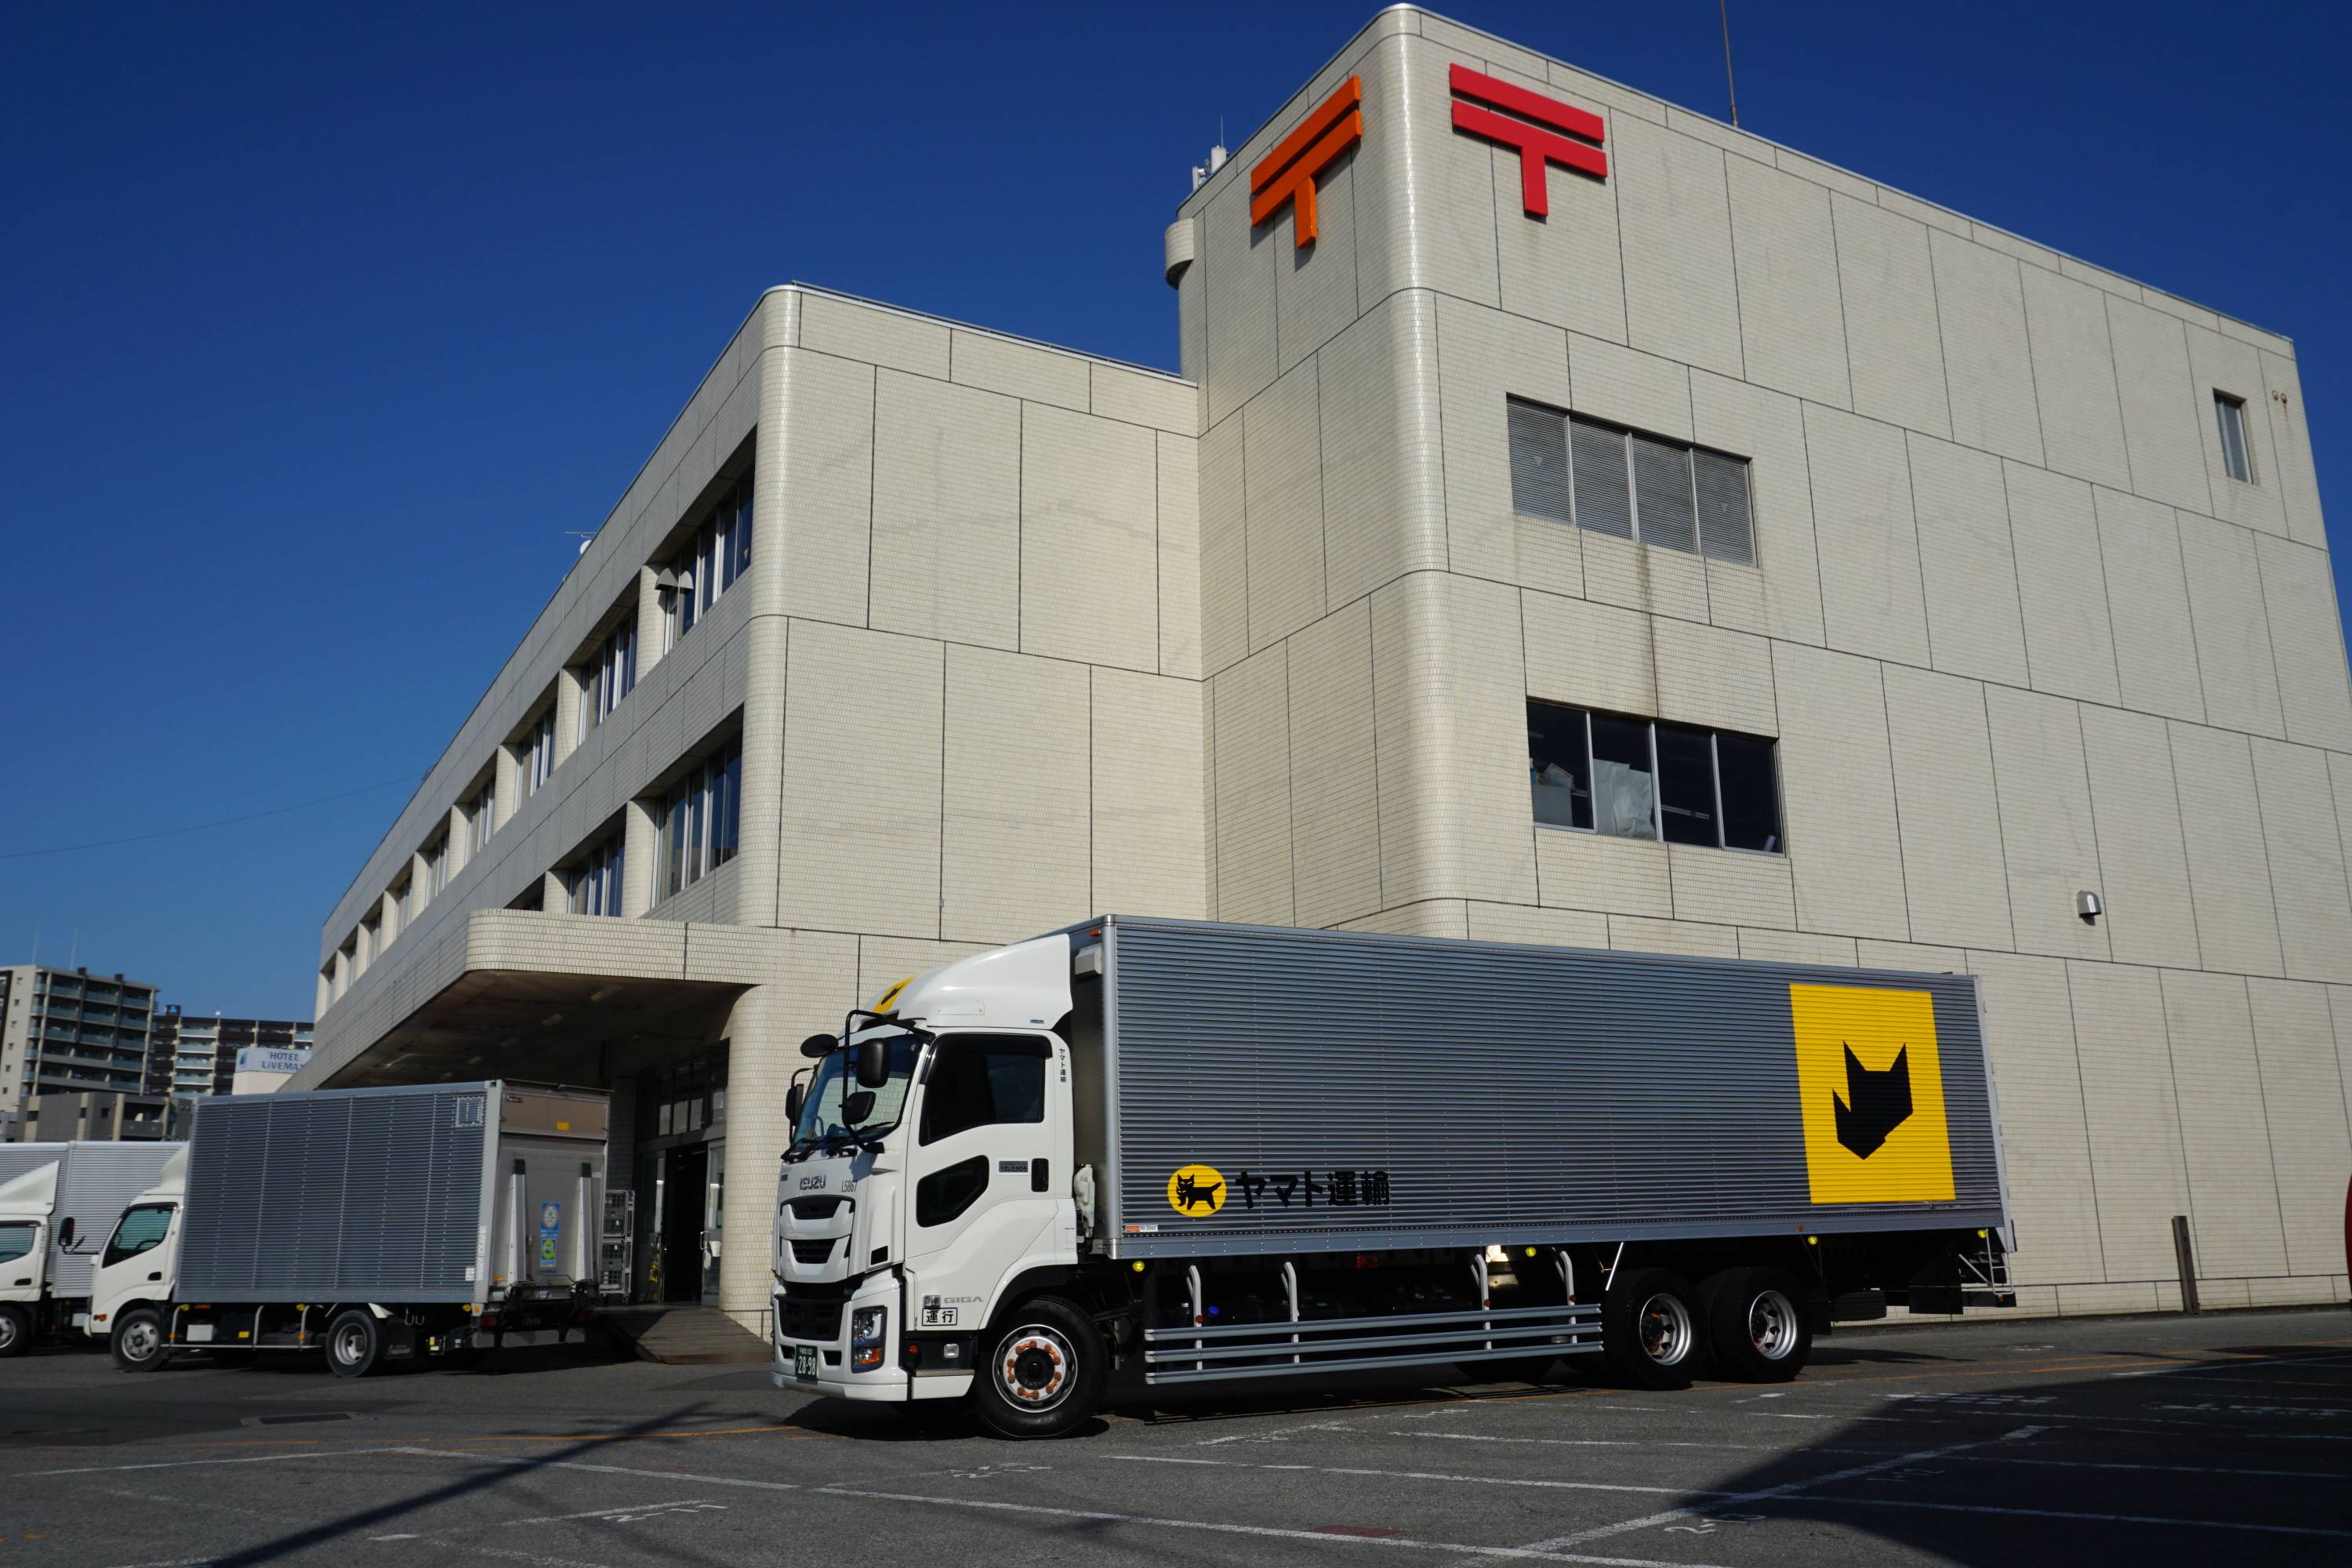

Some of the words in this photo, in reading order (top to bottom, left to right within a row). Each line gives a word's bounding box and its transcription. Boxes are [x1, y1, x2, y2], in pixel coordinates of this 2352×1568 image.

[270, 1051, 299, 1062] HOTEL
[800, 1175, 826, 1190] ISUZU
[1236, 1170, 1390, 1209] ヤマト運輸
[926, 1310, 954, 1323] 運行
[797, 1356, 816, 1376] 28-98
